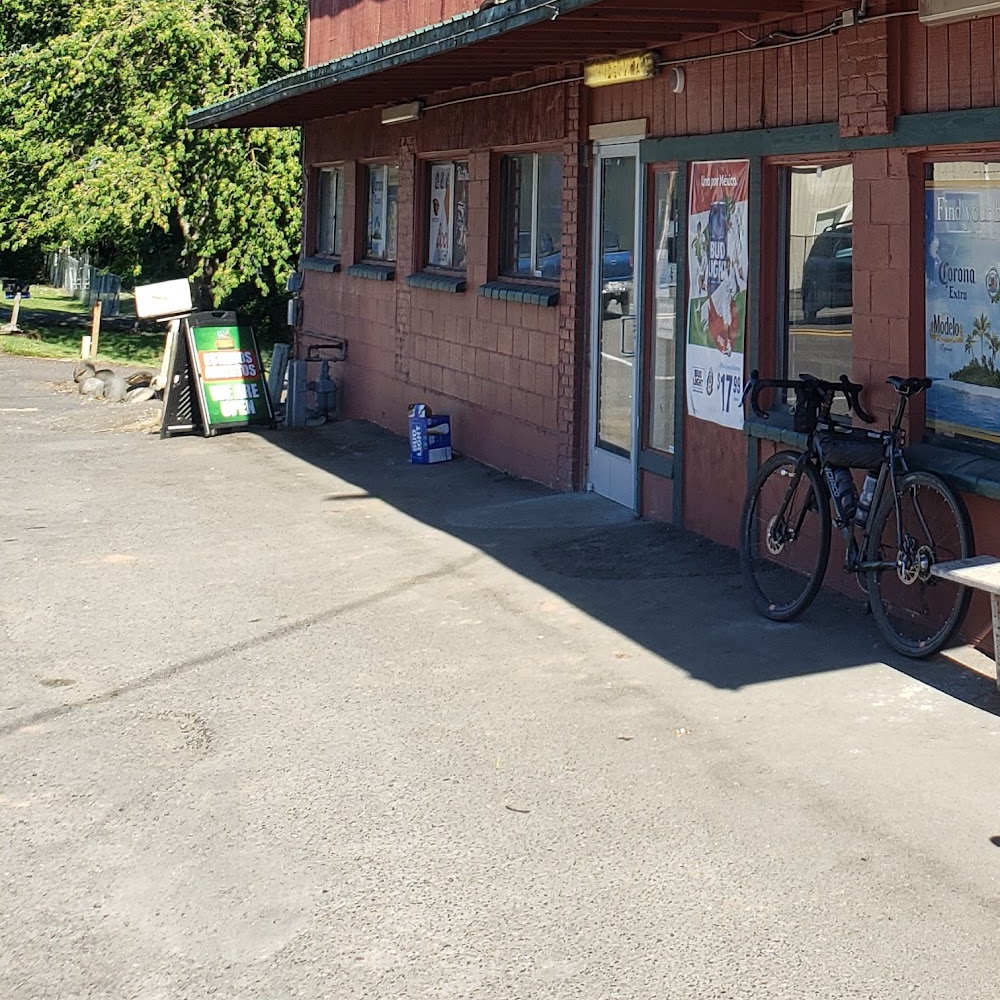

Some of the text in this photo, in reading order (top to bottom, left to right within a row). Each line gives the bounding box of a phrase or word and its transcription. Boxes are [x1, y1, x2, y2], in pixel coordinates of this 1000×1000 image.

[937, 197, 962, 221] Find
[710, 241, 726, 260] BUD
[938, 262, 976, 288] Corona
[933, 314, 960, 336] Modelo
